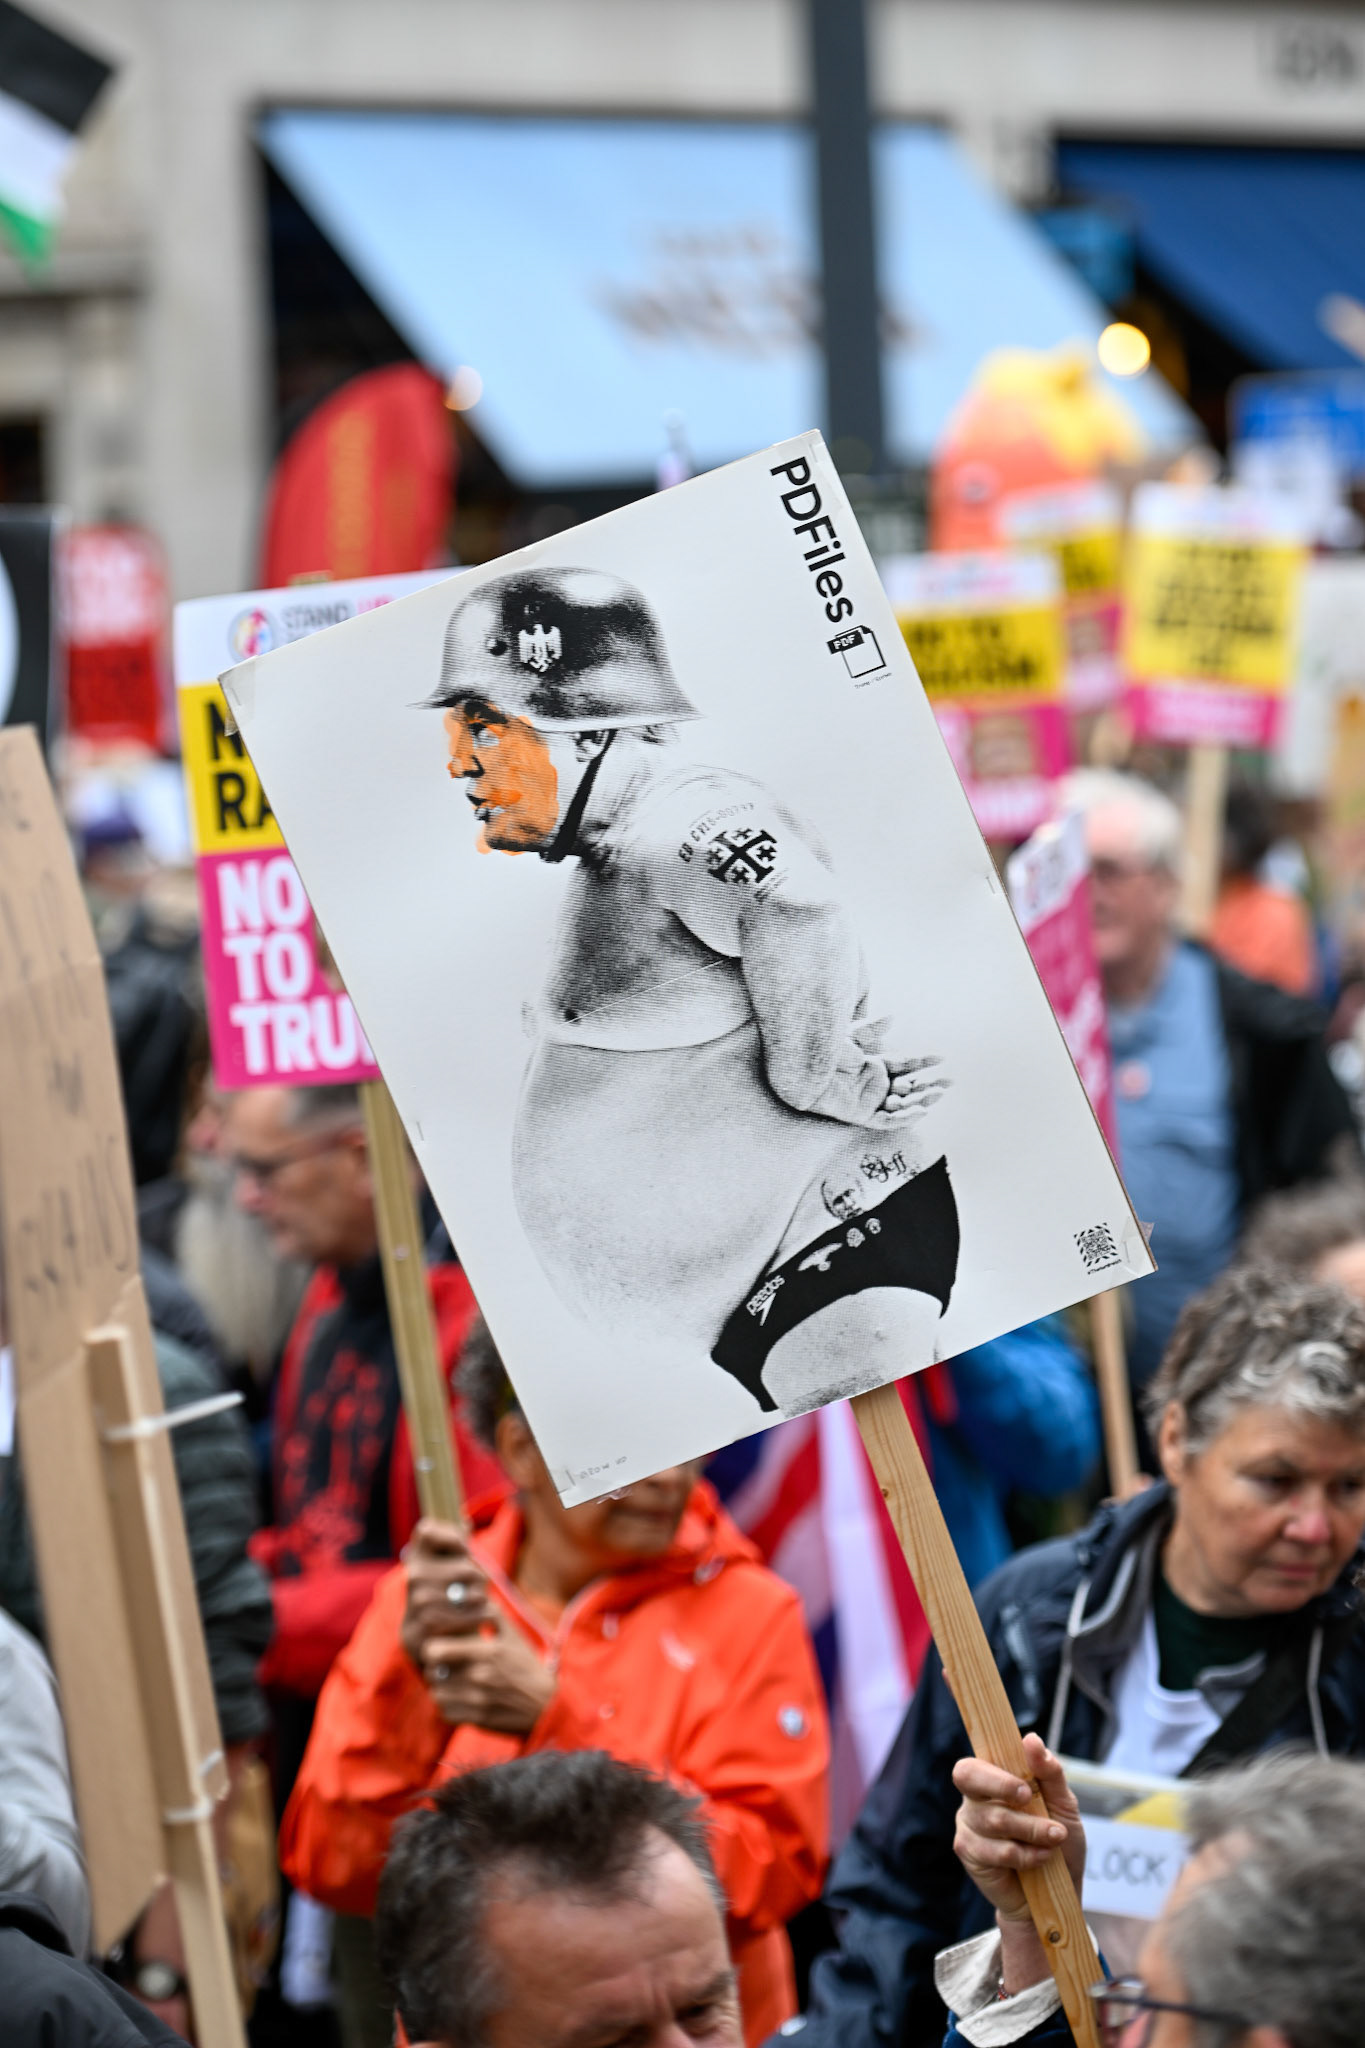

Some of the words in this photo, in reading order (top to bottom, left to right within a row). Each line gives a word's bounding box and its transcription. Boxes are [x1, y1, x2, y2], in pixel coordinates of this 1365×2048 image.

[769, 455, 854, 623] PDFiles
[282, 603, 351, 629] STAND
[832, 634, 856, 650] PDF
[216, 855, 311, 931] NO
[222, 929, 314, 1002] TO
[228, 992, 377, 1076] TRU
